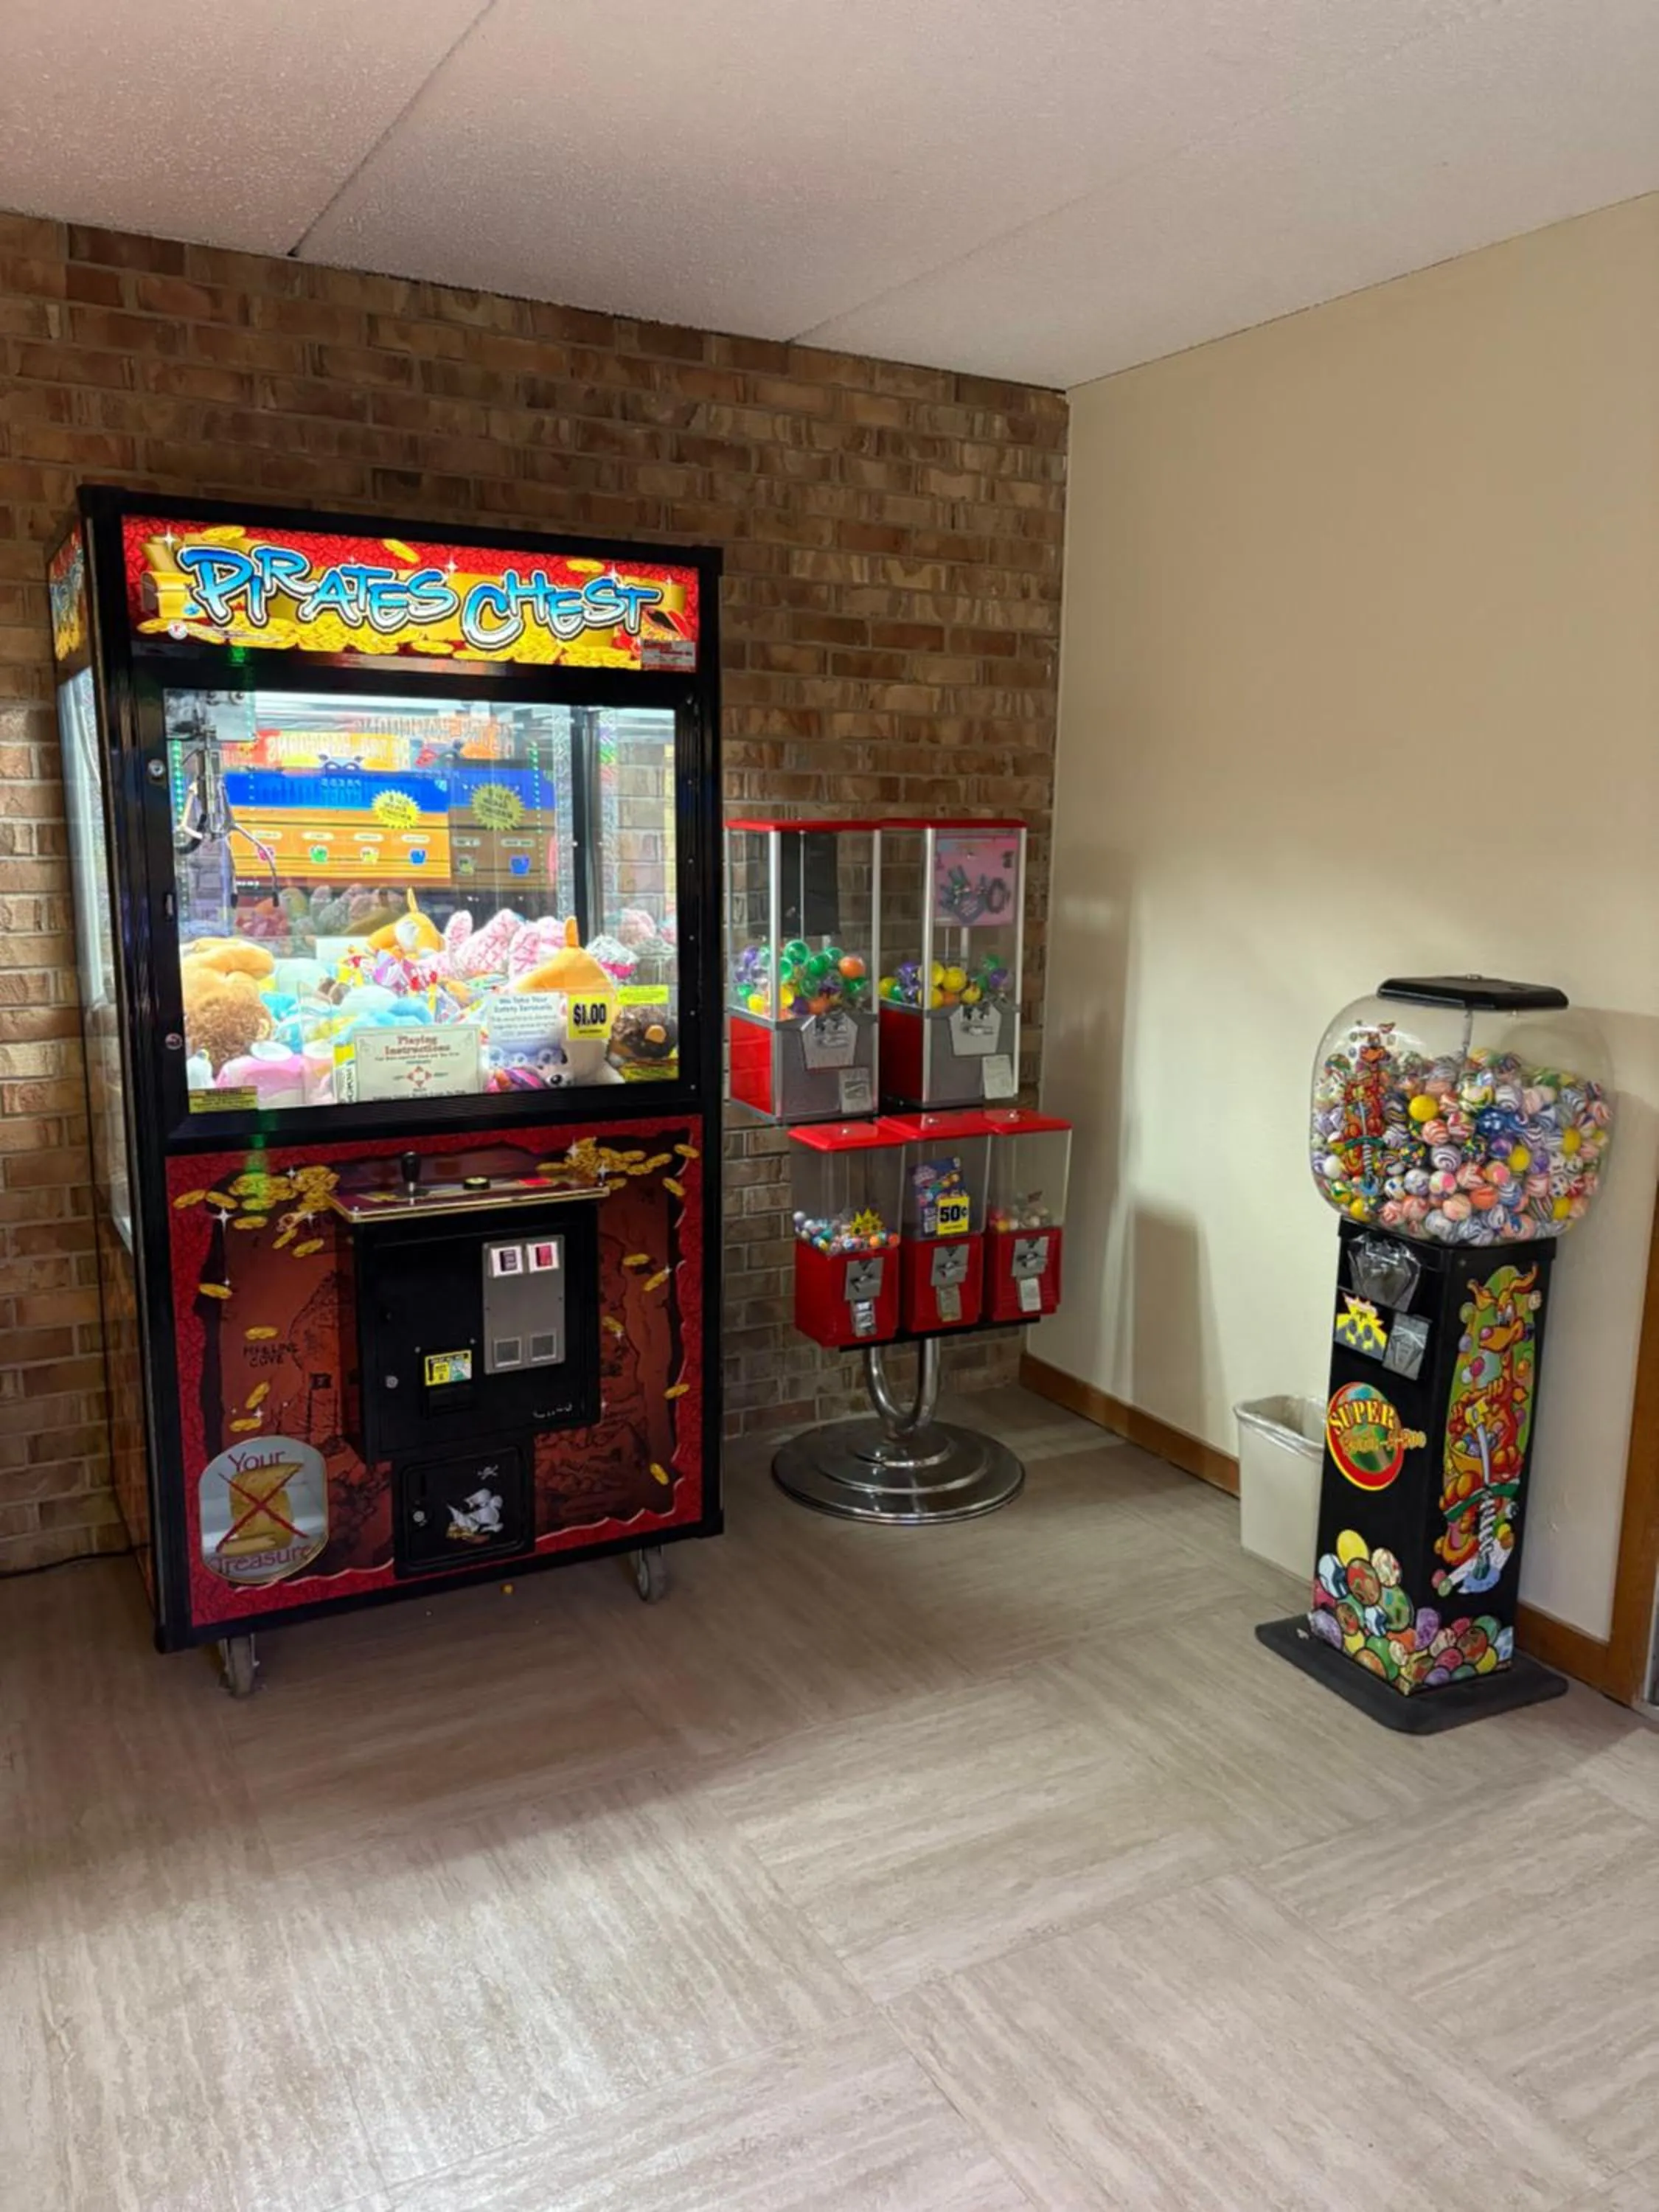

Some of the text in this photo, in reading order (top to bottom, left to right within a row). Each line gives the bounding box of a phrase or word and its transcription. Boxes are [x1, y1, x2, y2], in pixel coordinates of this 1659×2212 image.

[177, 545, 663, 650] PIRATES CHEST
[574, 1002, 606, 1026] $1.00
[384, 1044, 451, 1056] Instructions
[397, 1034, 438, 1046] Playing
[1329, 1399, 1397, 1436] SUPER
[227, 1450, 286, 1472] Your
